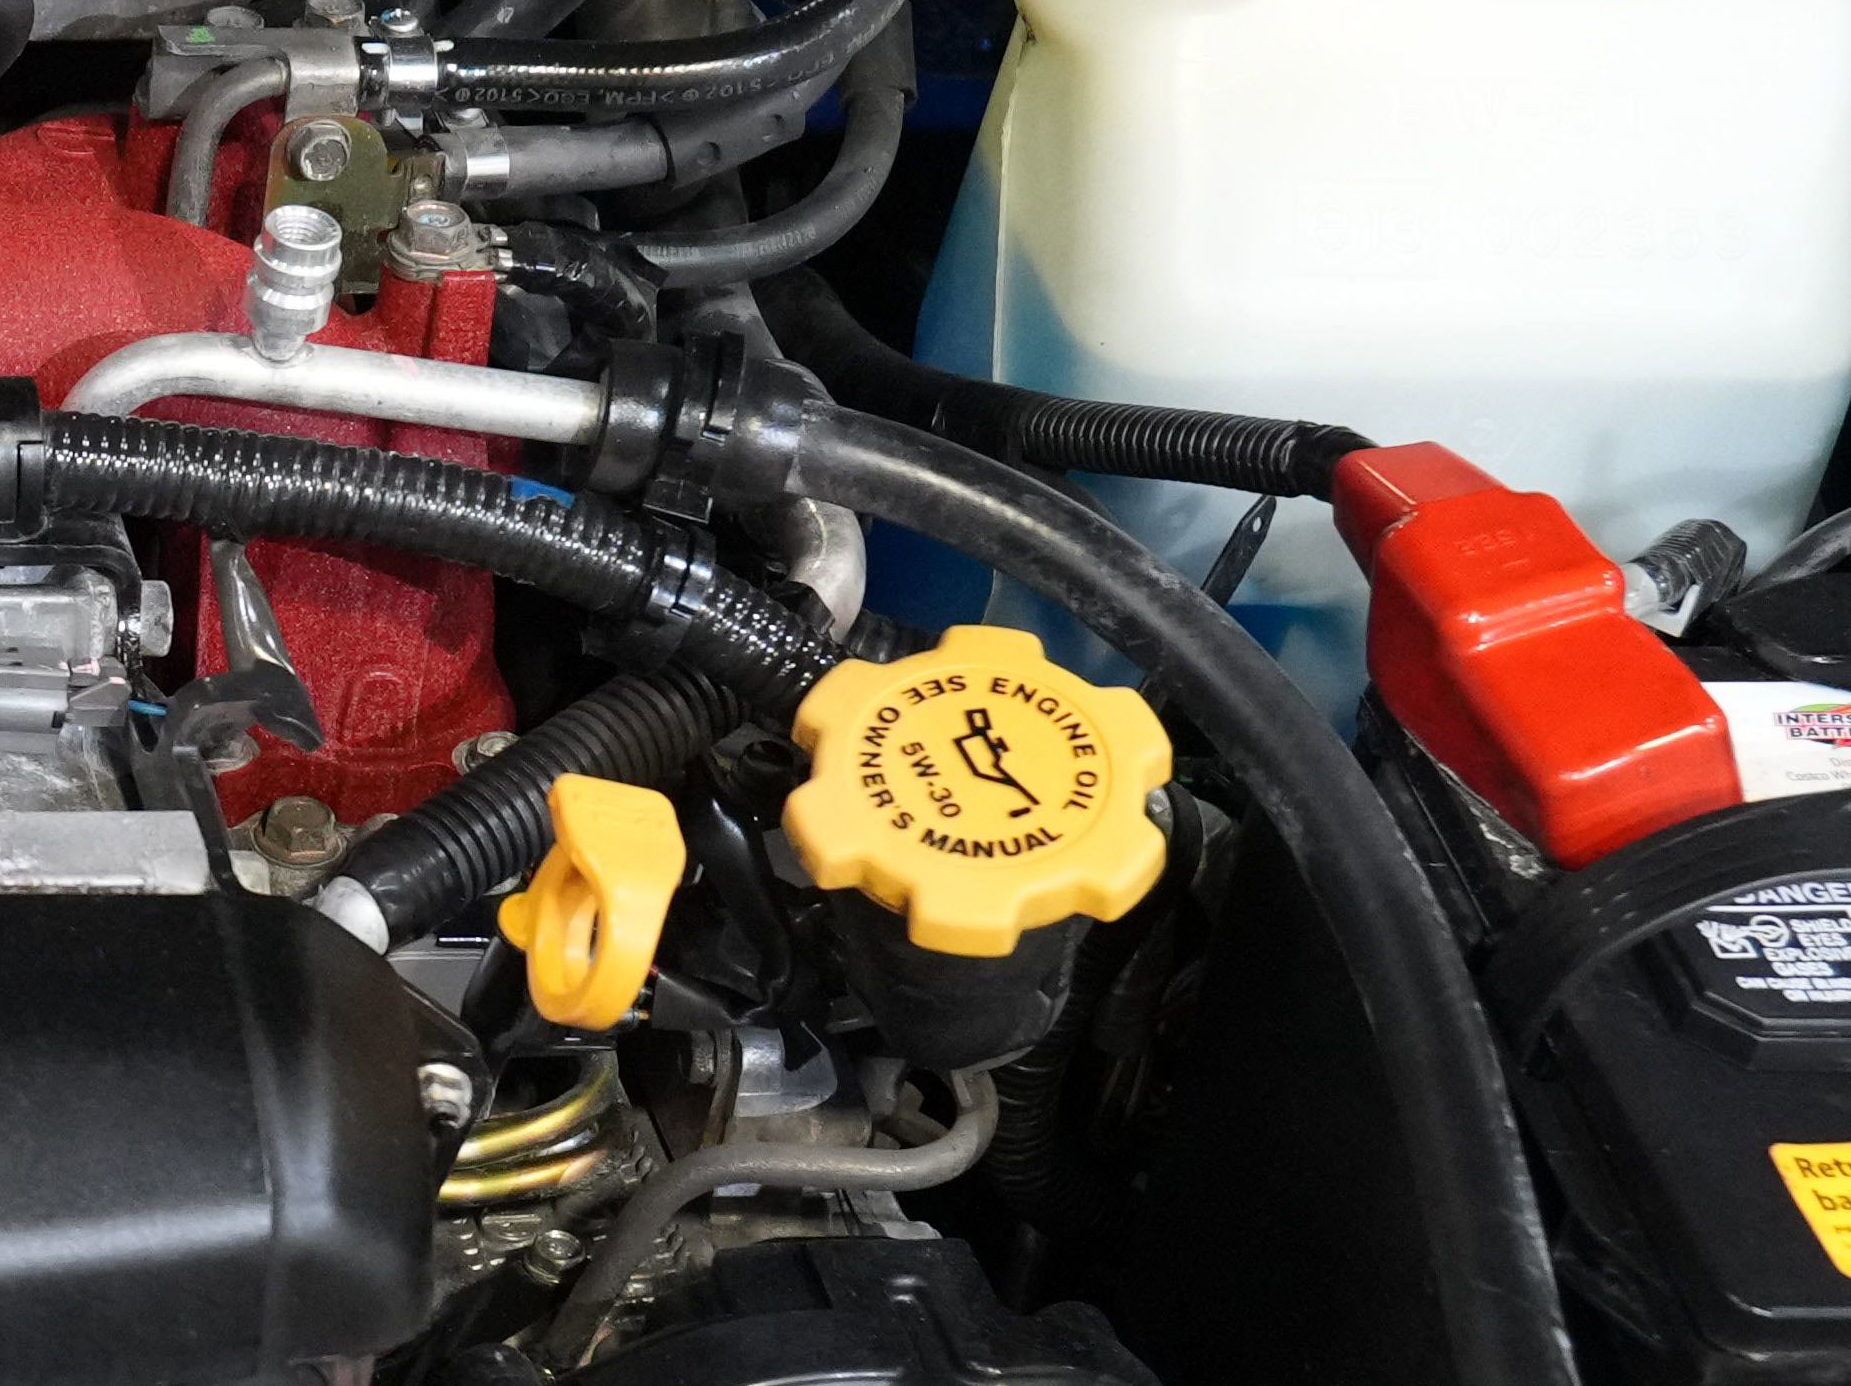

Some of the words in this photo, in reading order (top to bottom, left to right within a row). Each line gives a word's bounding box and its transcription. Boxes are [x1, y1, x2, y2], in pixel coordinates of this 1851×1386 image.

[902, 675, 967, 705] SEE
[991, 677, 1097, 758] ENGINE
[1063, 772, 1097, 812] OIL
[1790, 727, 1851, 737] BATT
[860, 706, 915, 830] OWNER'S
[920, 827, 1062, 857] MANUAL
[1797, 933, 1848, 947] EYES
